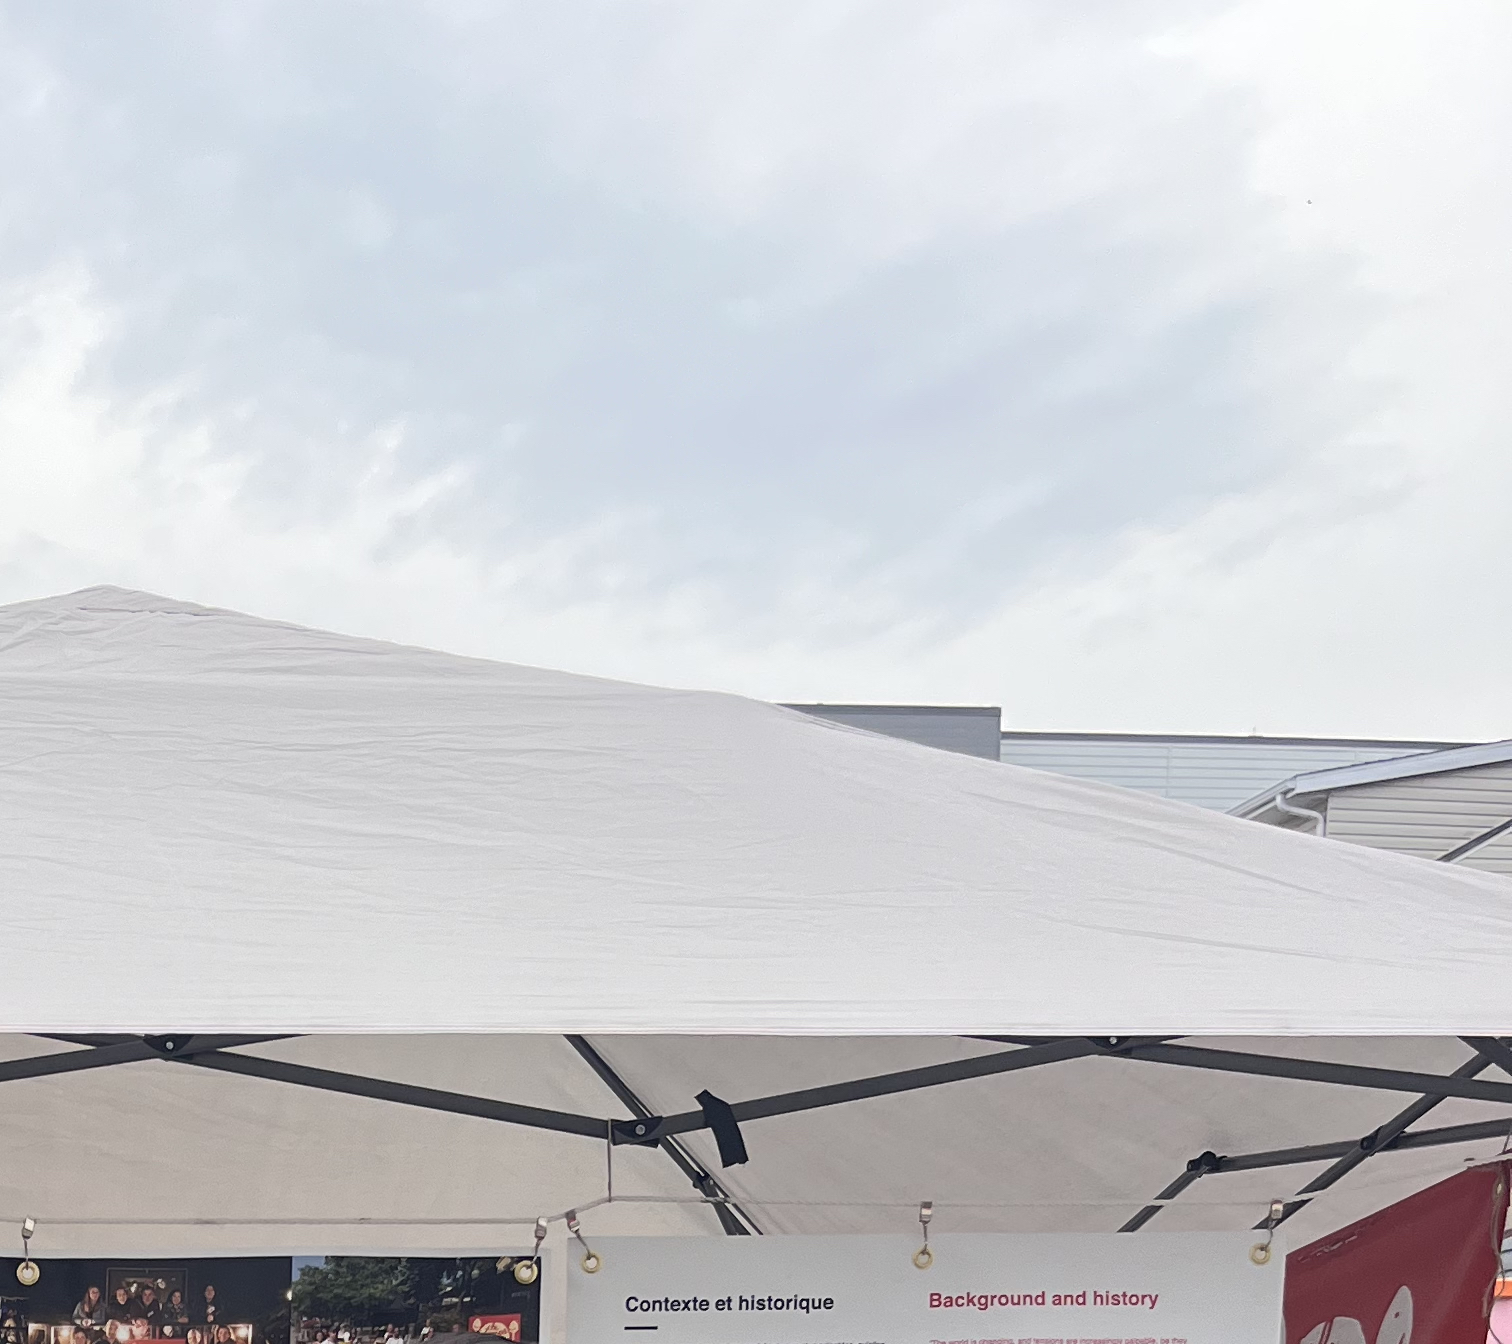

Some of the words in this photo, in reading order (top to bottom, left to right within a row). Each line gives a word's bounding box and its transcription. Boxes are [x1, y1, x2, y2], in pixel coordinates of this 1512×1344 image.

[625, 1295, 709, 1313] Contexte
[715, 1297, 732, 1311] et
[738, 1295, 834, 1313] historique
[929, 1291, 1045, 1310] Background
[1052, 1291, 1086, 1306] and
[1094, 1290, 1158, 1310] history
